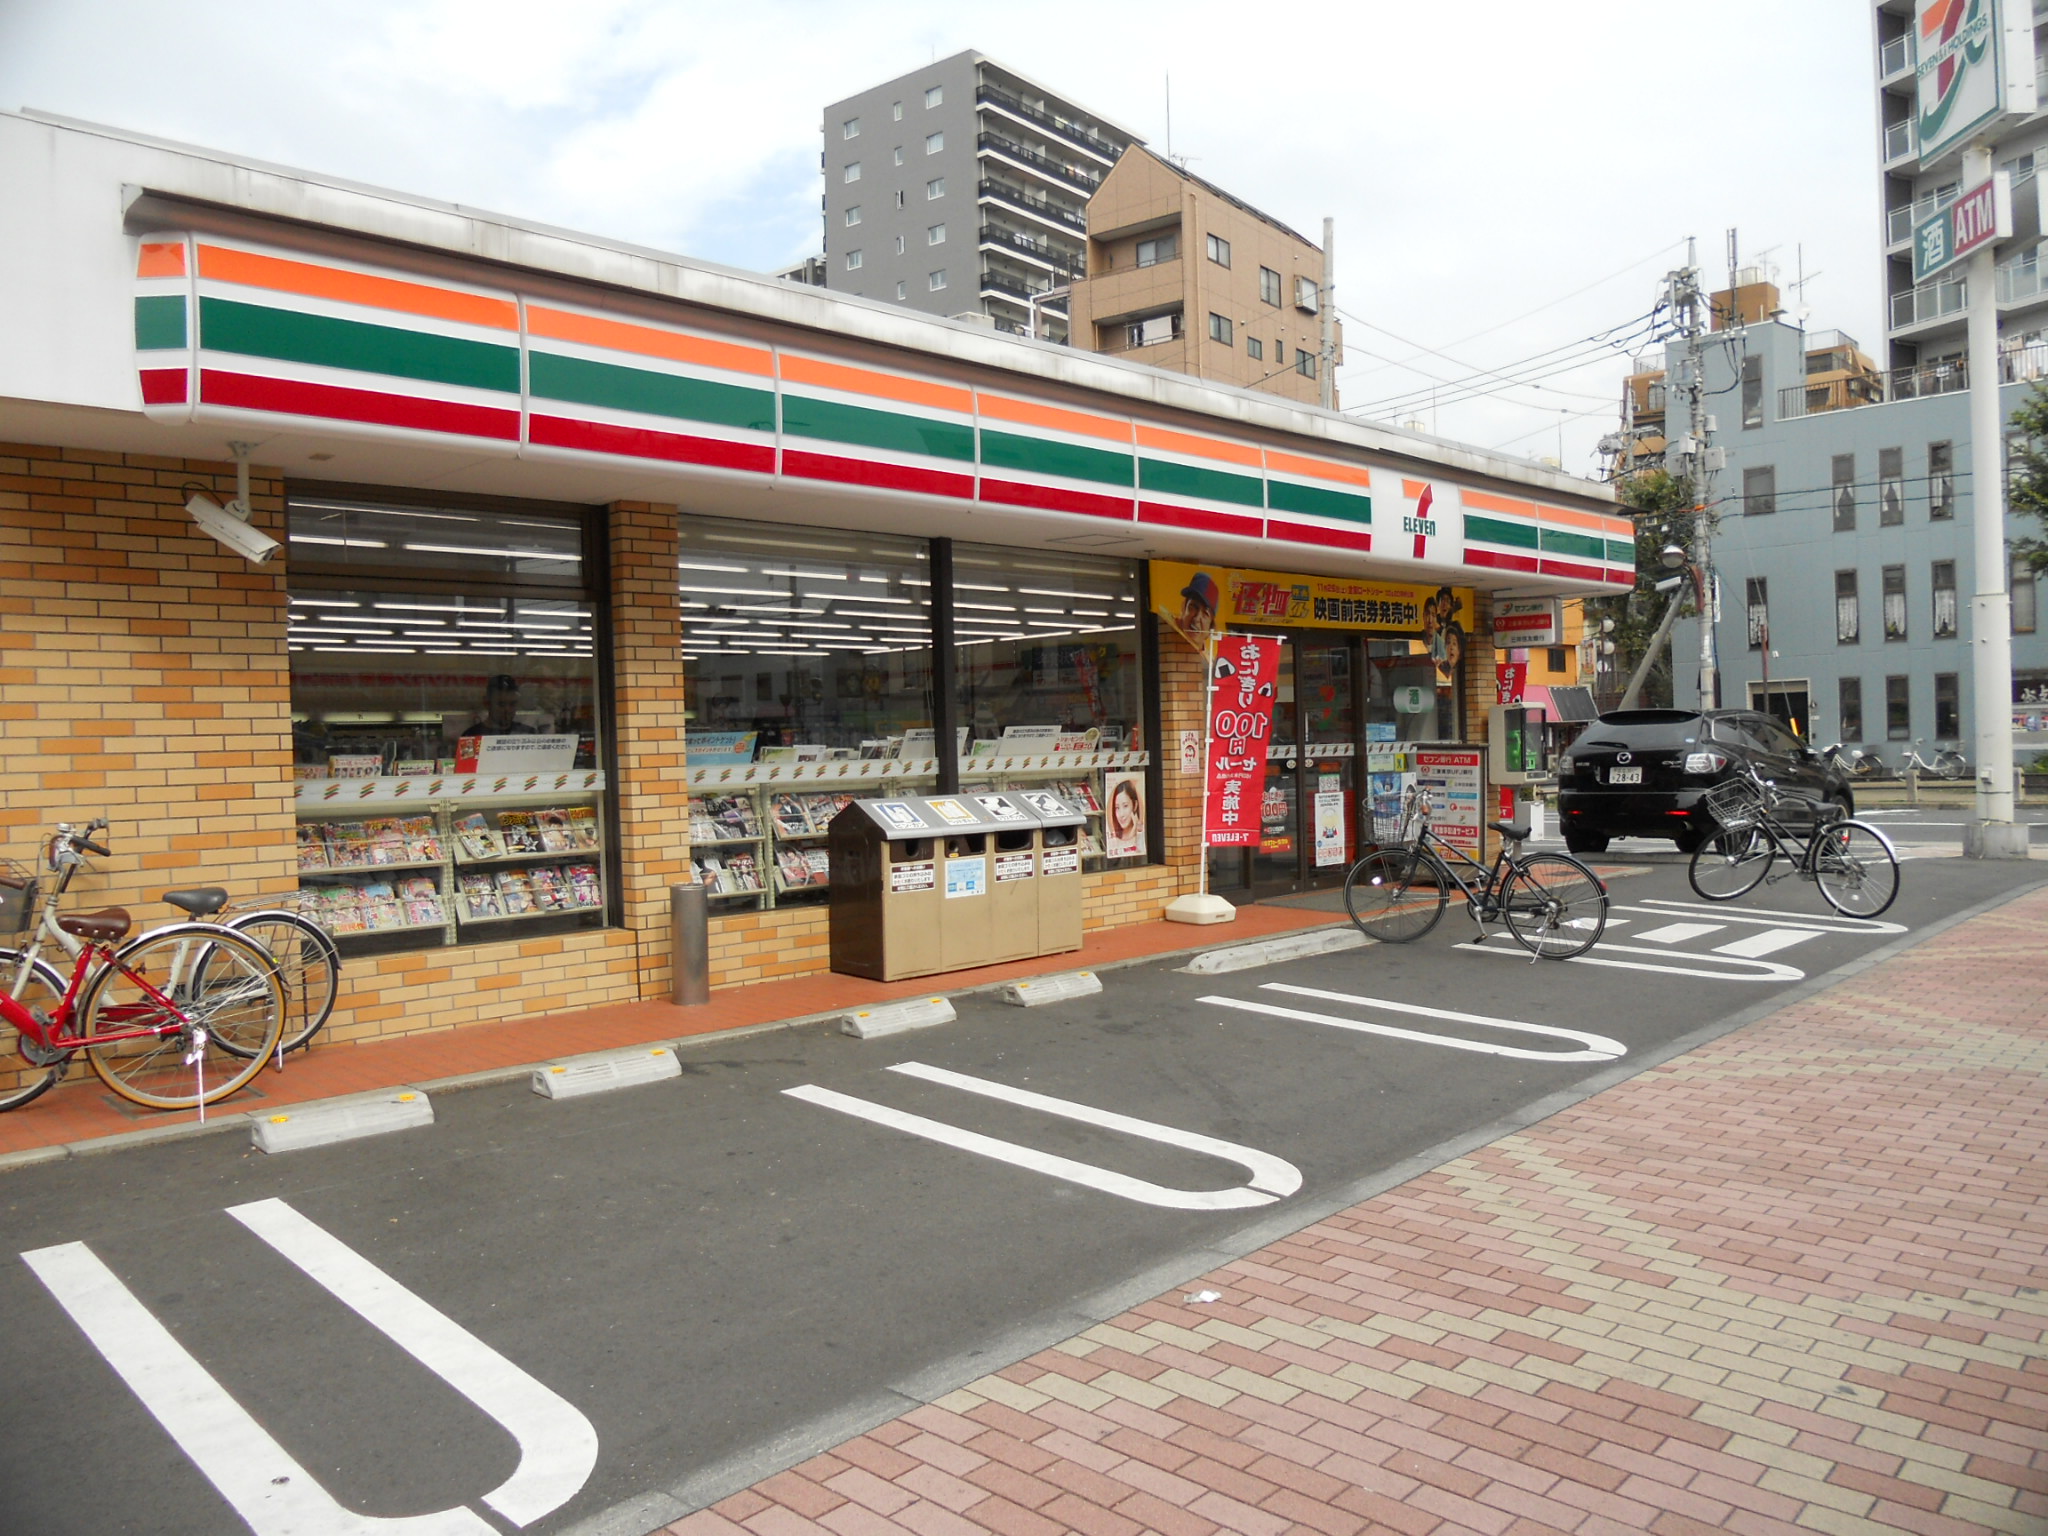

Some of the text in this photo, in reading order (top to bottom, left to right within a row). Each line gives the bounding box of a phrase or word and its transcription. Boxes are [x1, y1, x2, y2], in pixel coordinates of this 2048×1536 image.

[1947, 13, 1988, 54] HOLDINGS
[1955, 189, 1993, 249] ATM
[1922, 218, 1944, 271] 酒
[1514, 604, 1544, 613] セブン銀行
[1408, 689, 1420, 705] 酒
[1423, 756, 1452, 764] セブン銀行
